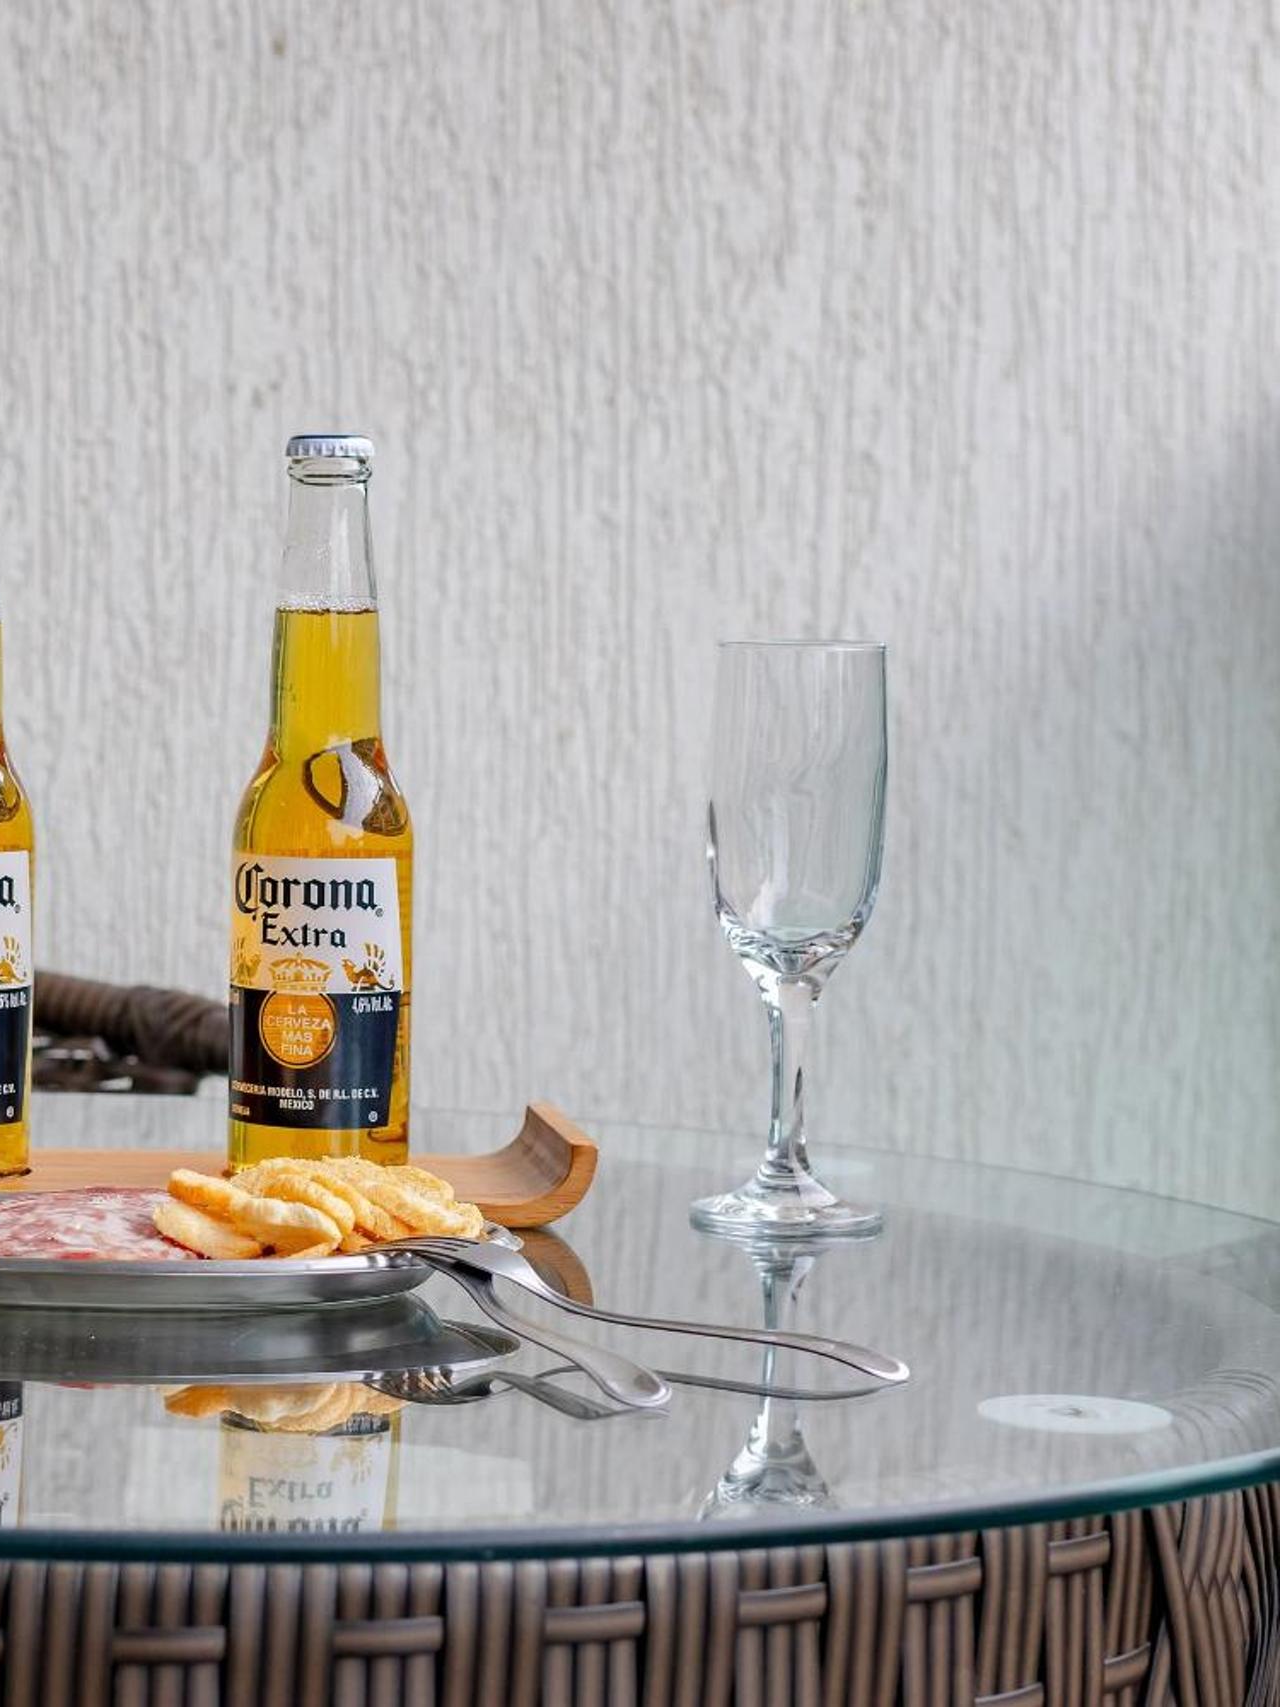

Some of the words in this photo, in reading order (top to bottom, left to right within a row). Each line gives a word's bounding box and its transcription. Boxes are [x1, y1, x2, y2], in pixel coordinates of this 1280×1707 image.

[235, 861, 377, 921] Corona
[261, 911, 346, 948] Extra
[287, 1004, 307, 1015] LA
[264, 1015, 332, 1030] CERVEZA
[282, 1031, 313, 1043] MAS
[281, 1044, 313, 1057] FINA
[319, 1088, 332, 1100] DE
[352, 1088, 363, 1099] DE
[279, 1098, 315, 1110] MEXICO
